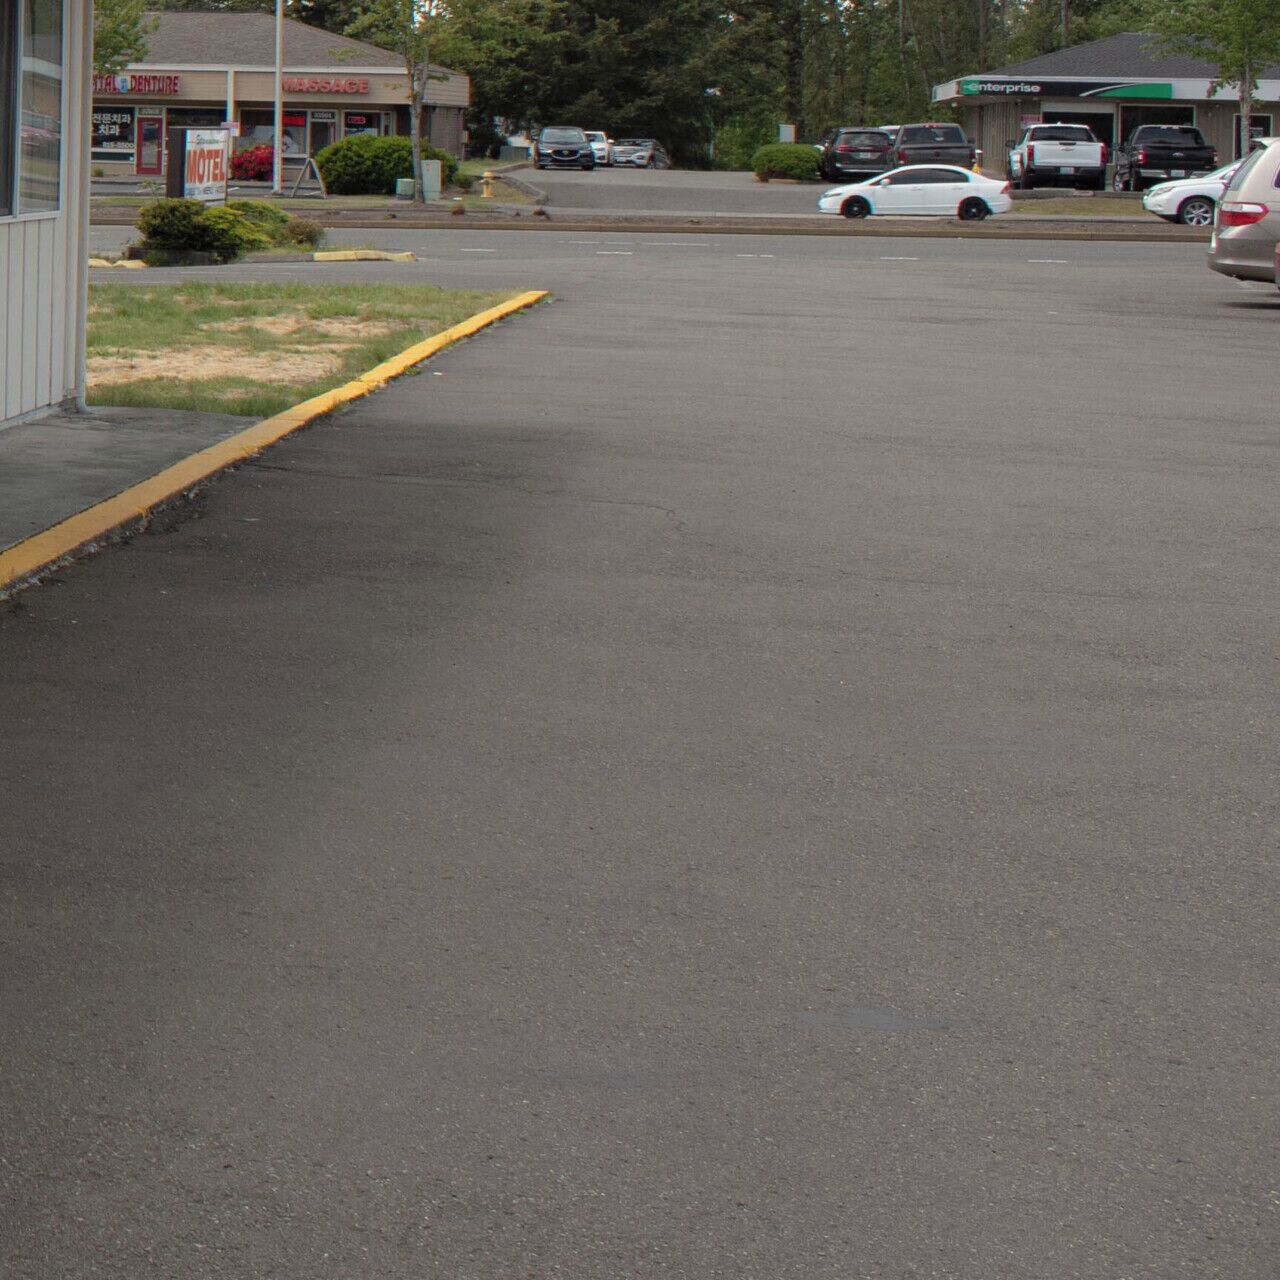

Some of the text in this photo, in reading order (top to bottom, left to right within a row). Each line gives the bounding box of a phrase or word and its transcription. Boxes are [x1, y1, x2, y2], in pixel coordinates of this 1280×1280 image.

[130, 75, 180, 93] DENTURE
[966, 83, 1041, 94] enterprise
[186, 148, 225, 185] MOTEL
